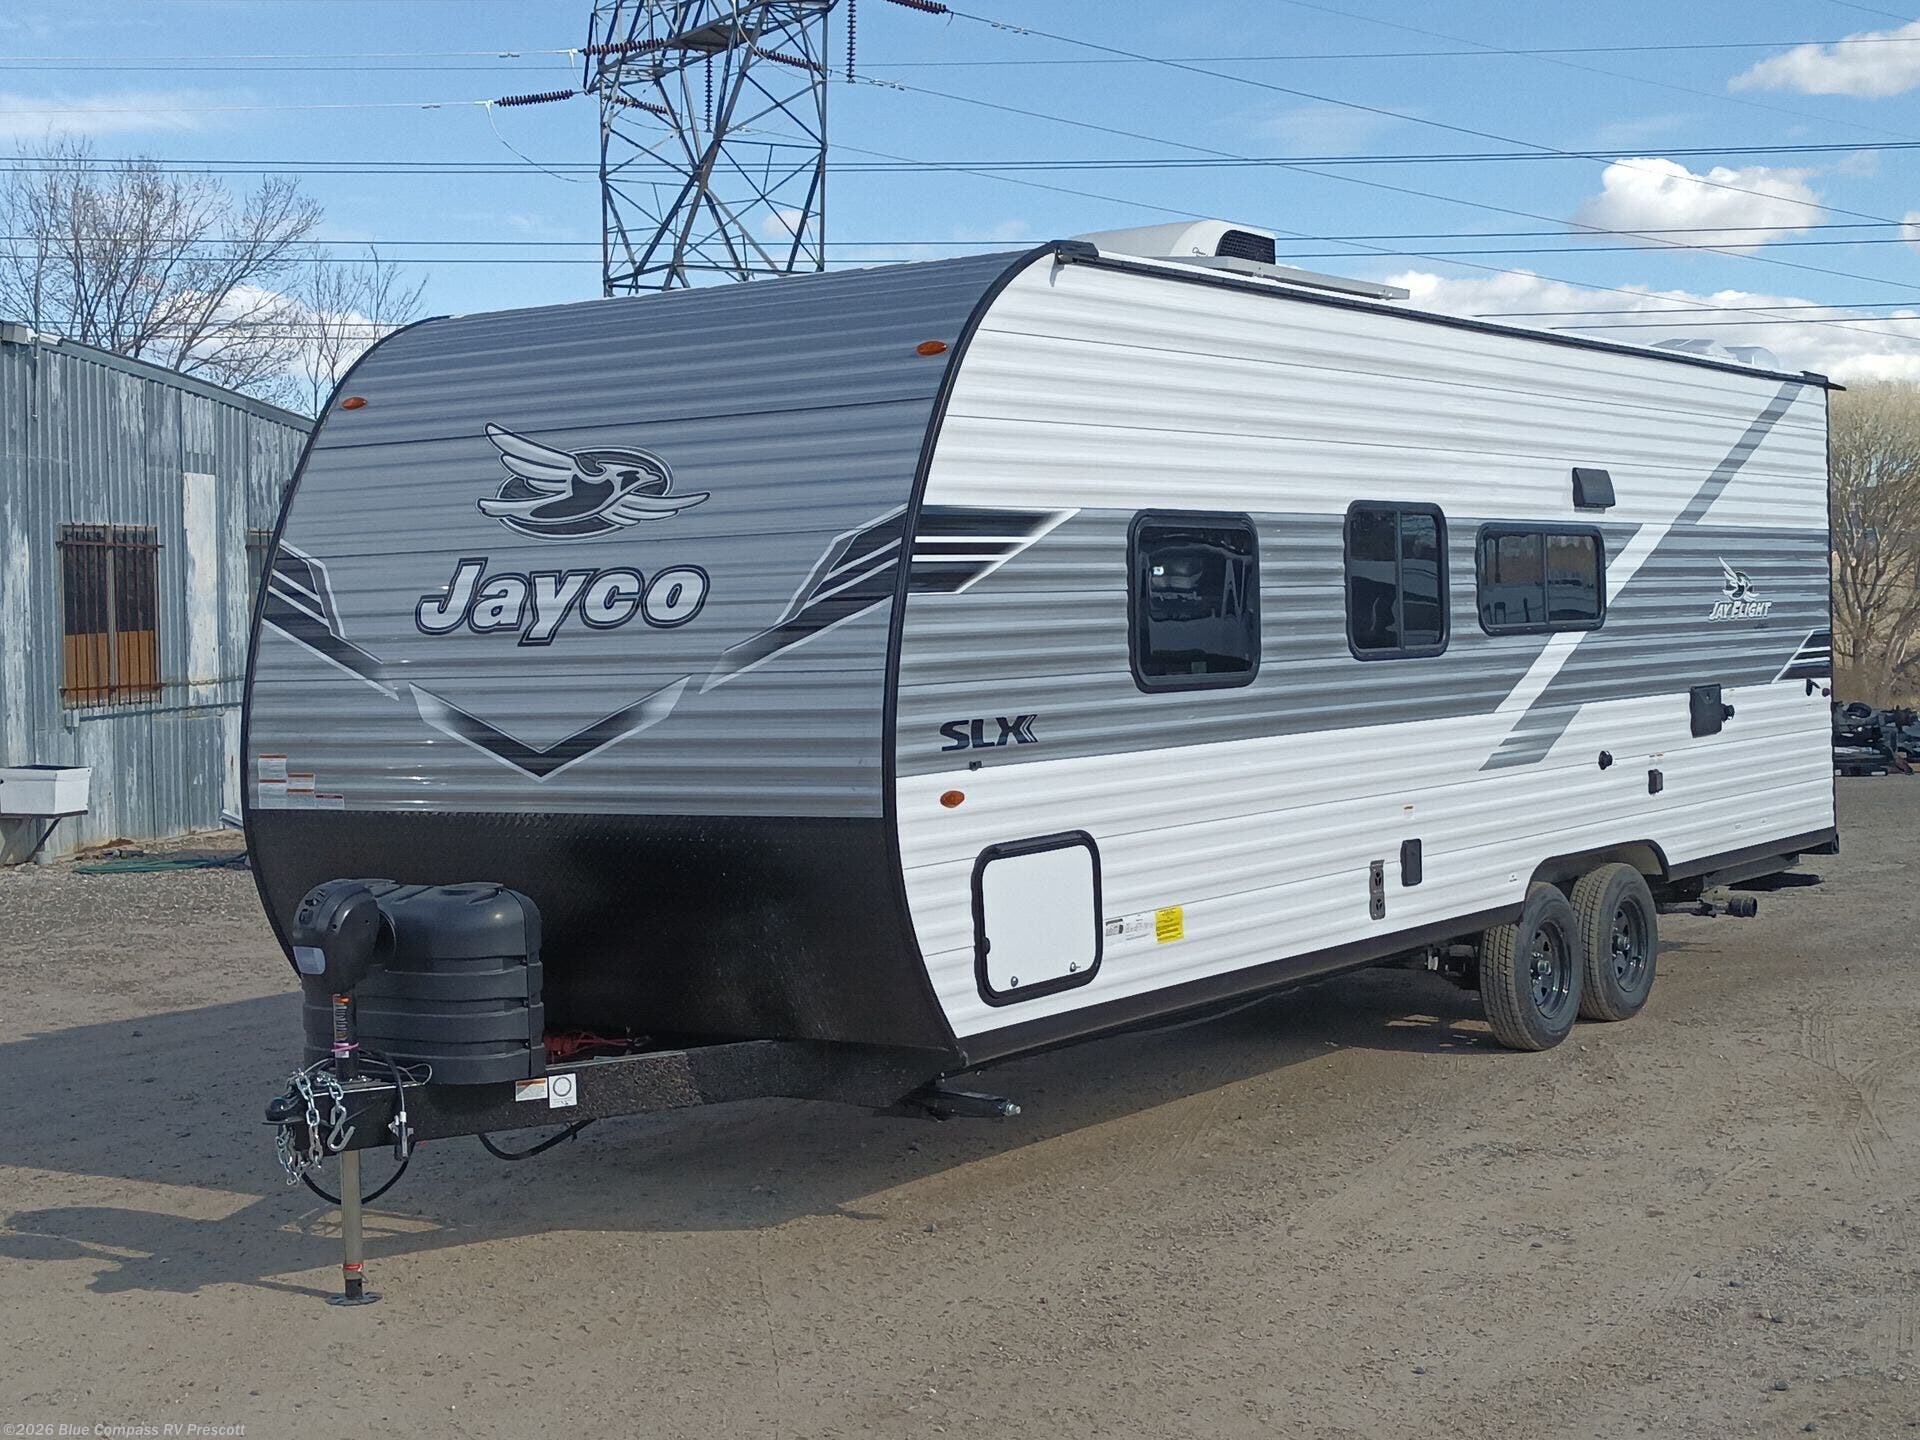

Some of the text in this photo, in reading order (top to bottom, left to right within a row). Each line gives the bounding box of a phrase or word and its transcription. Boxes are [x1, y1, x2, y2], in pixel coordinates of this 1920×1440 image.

[415, 557, 710, 646] Jayco
[1708, 600, 1772, 621] JAY FLIGHT
[940, 714, 1038, 751] SLX
